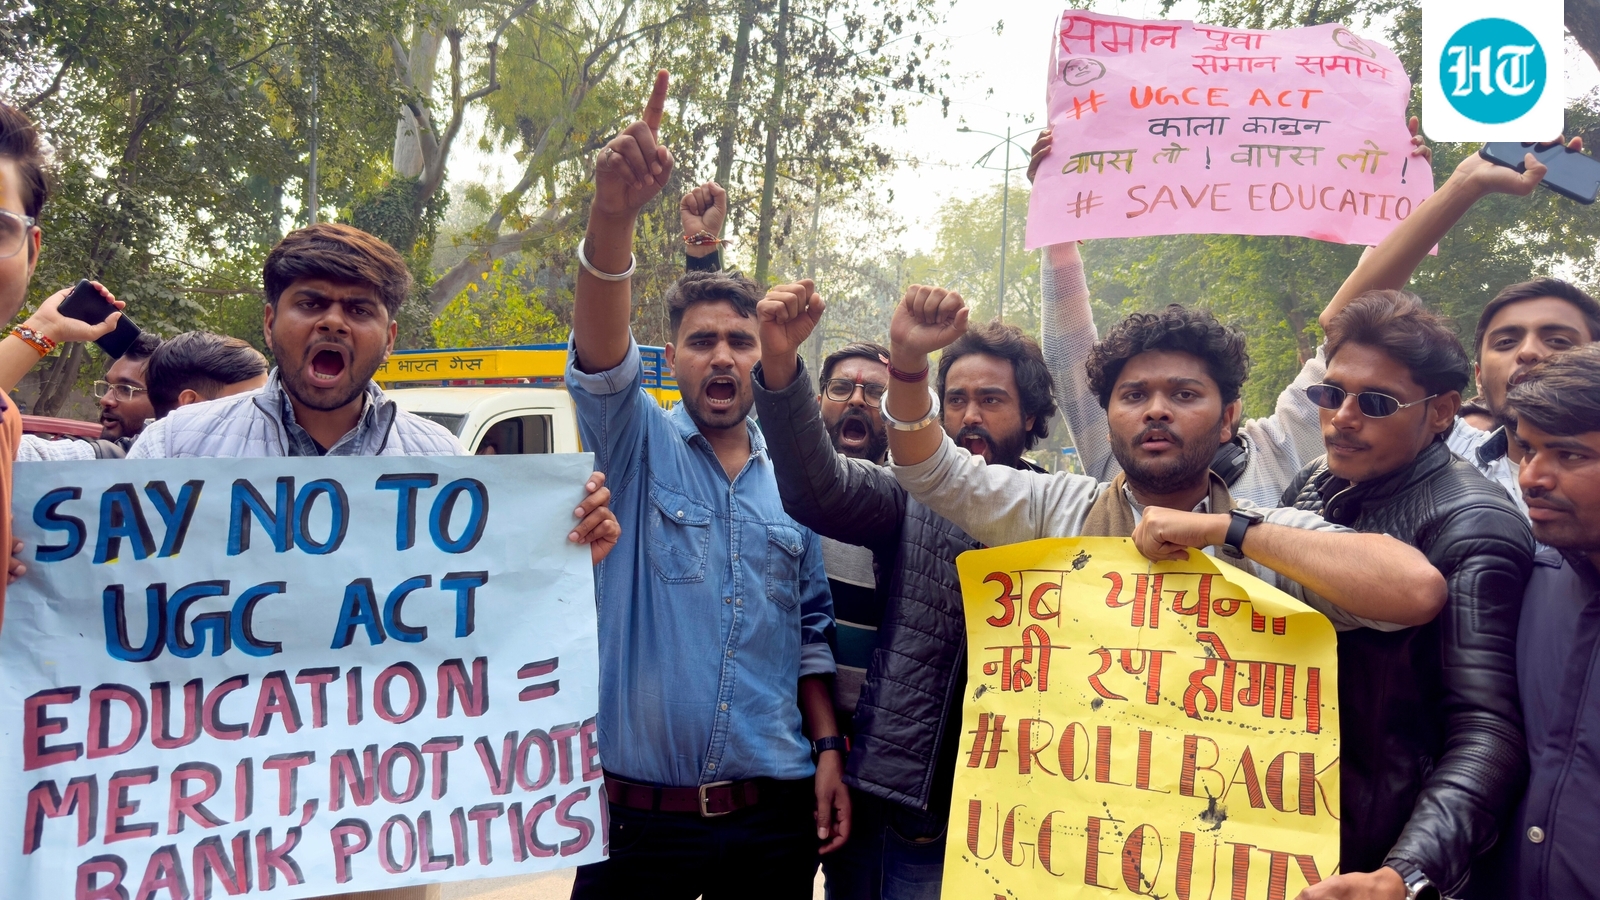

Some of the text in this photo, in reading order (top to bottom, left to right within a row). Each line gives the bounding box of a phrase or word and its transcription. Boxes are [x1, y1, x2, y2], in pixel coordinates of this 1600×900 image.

[1059, 16, 1182, 55] समान
[1191, 55, 1282, 76] समान
[1130, 86, 1229, 108] UGCE
[1249, 88, 1324, 109] ACT
[1062, 149, 1138, 174] वापस
[1230, 144, 1325, 168] वापस
[1337, 139, 1389, 174] लो
[1148, 117, 1231, 138] काला
[1126, 183, 1232, 219] SAVE
[1248, 182, 1425, 221] EDUCATIO
[398, 359, 438, 373] भारत
[450, 356, 483, 371] गैस
[33, 473, 489, 565] SAY NO TO
[102, 571, 488, 662] UGC ACT
[983, 569, 1071, 628] अब
[1087, 645, 1177, 705] रण
[23, 656, 489, 771] EDUCATION
[474, 713, 603, 795] VOTE
[75, 826, 306, 900] BANK
[966, 799, 1065, 877] UGC
